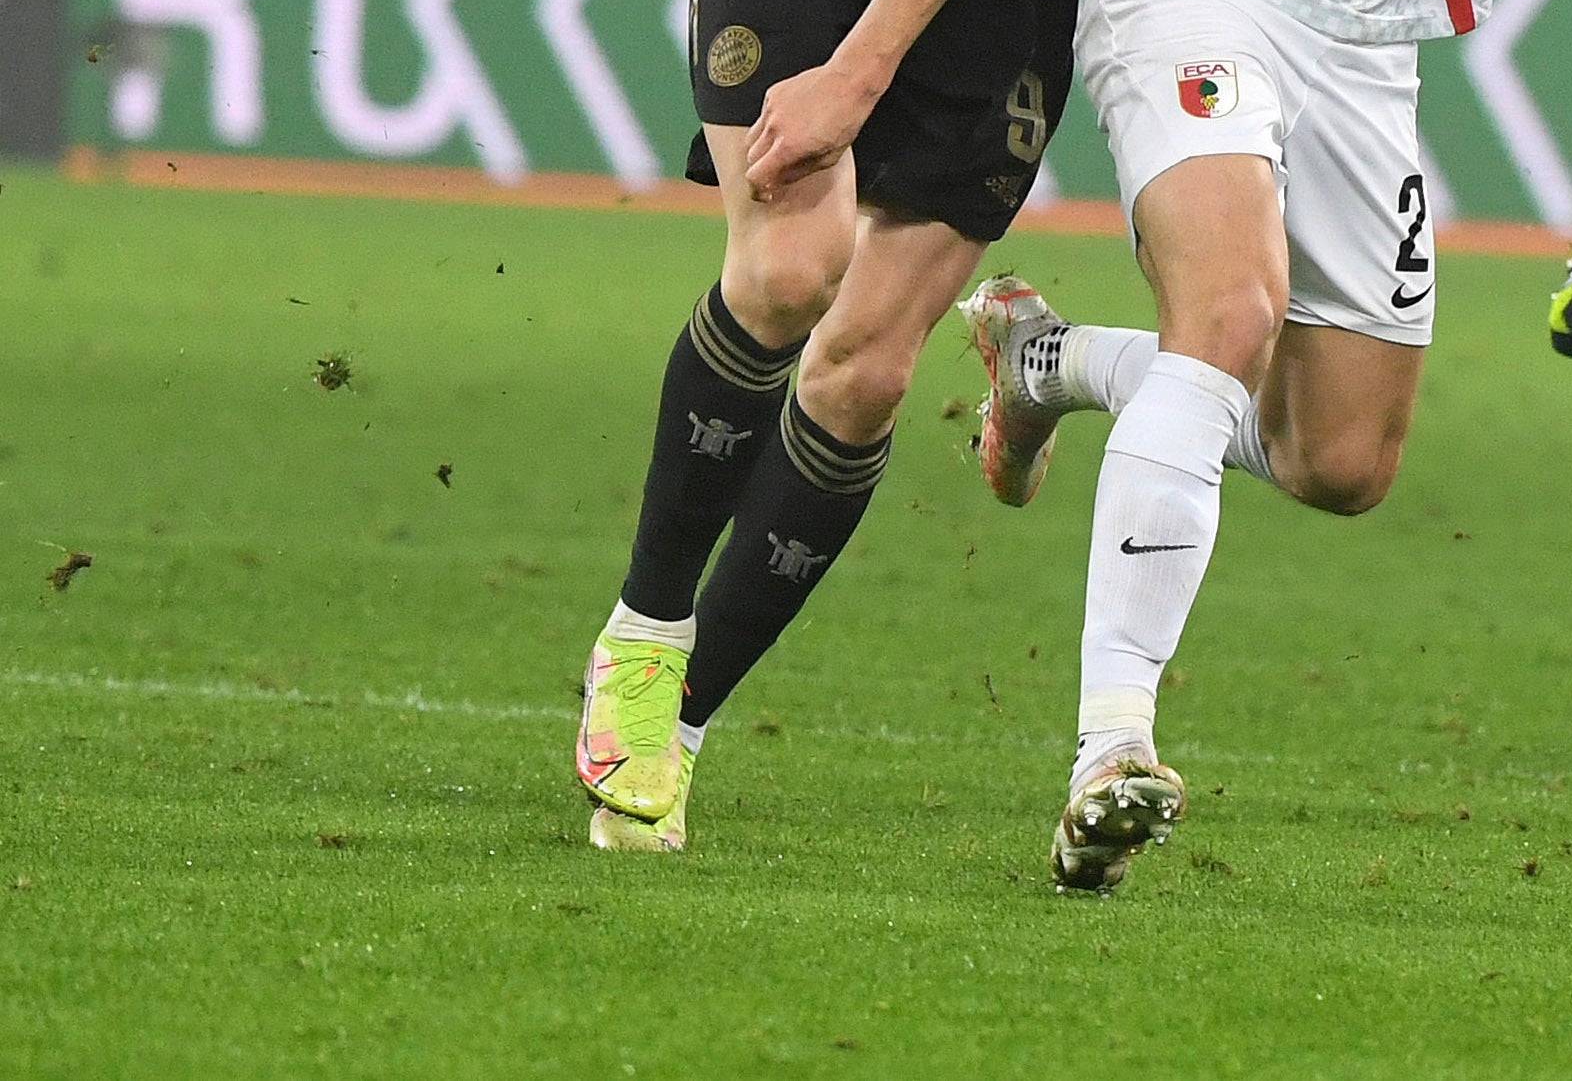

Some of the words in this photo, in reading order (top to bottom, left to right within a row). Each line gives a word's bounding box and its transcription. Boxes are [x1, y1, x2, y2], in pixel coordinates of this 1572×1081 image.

[721, 30, 755, 49] BAYERN
[1006, 69, 1047, 164] 9
[1394, 174, 1430, 272] 2
